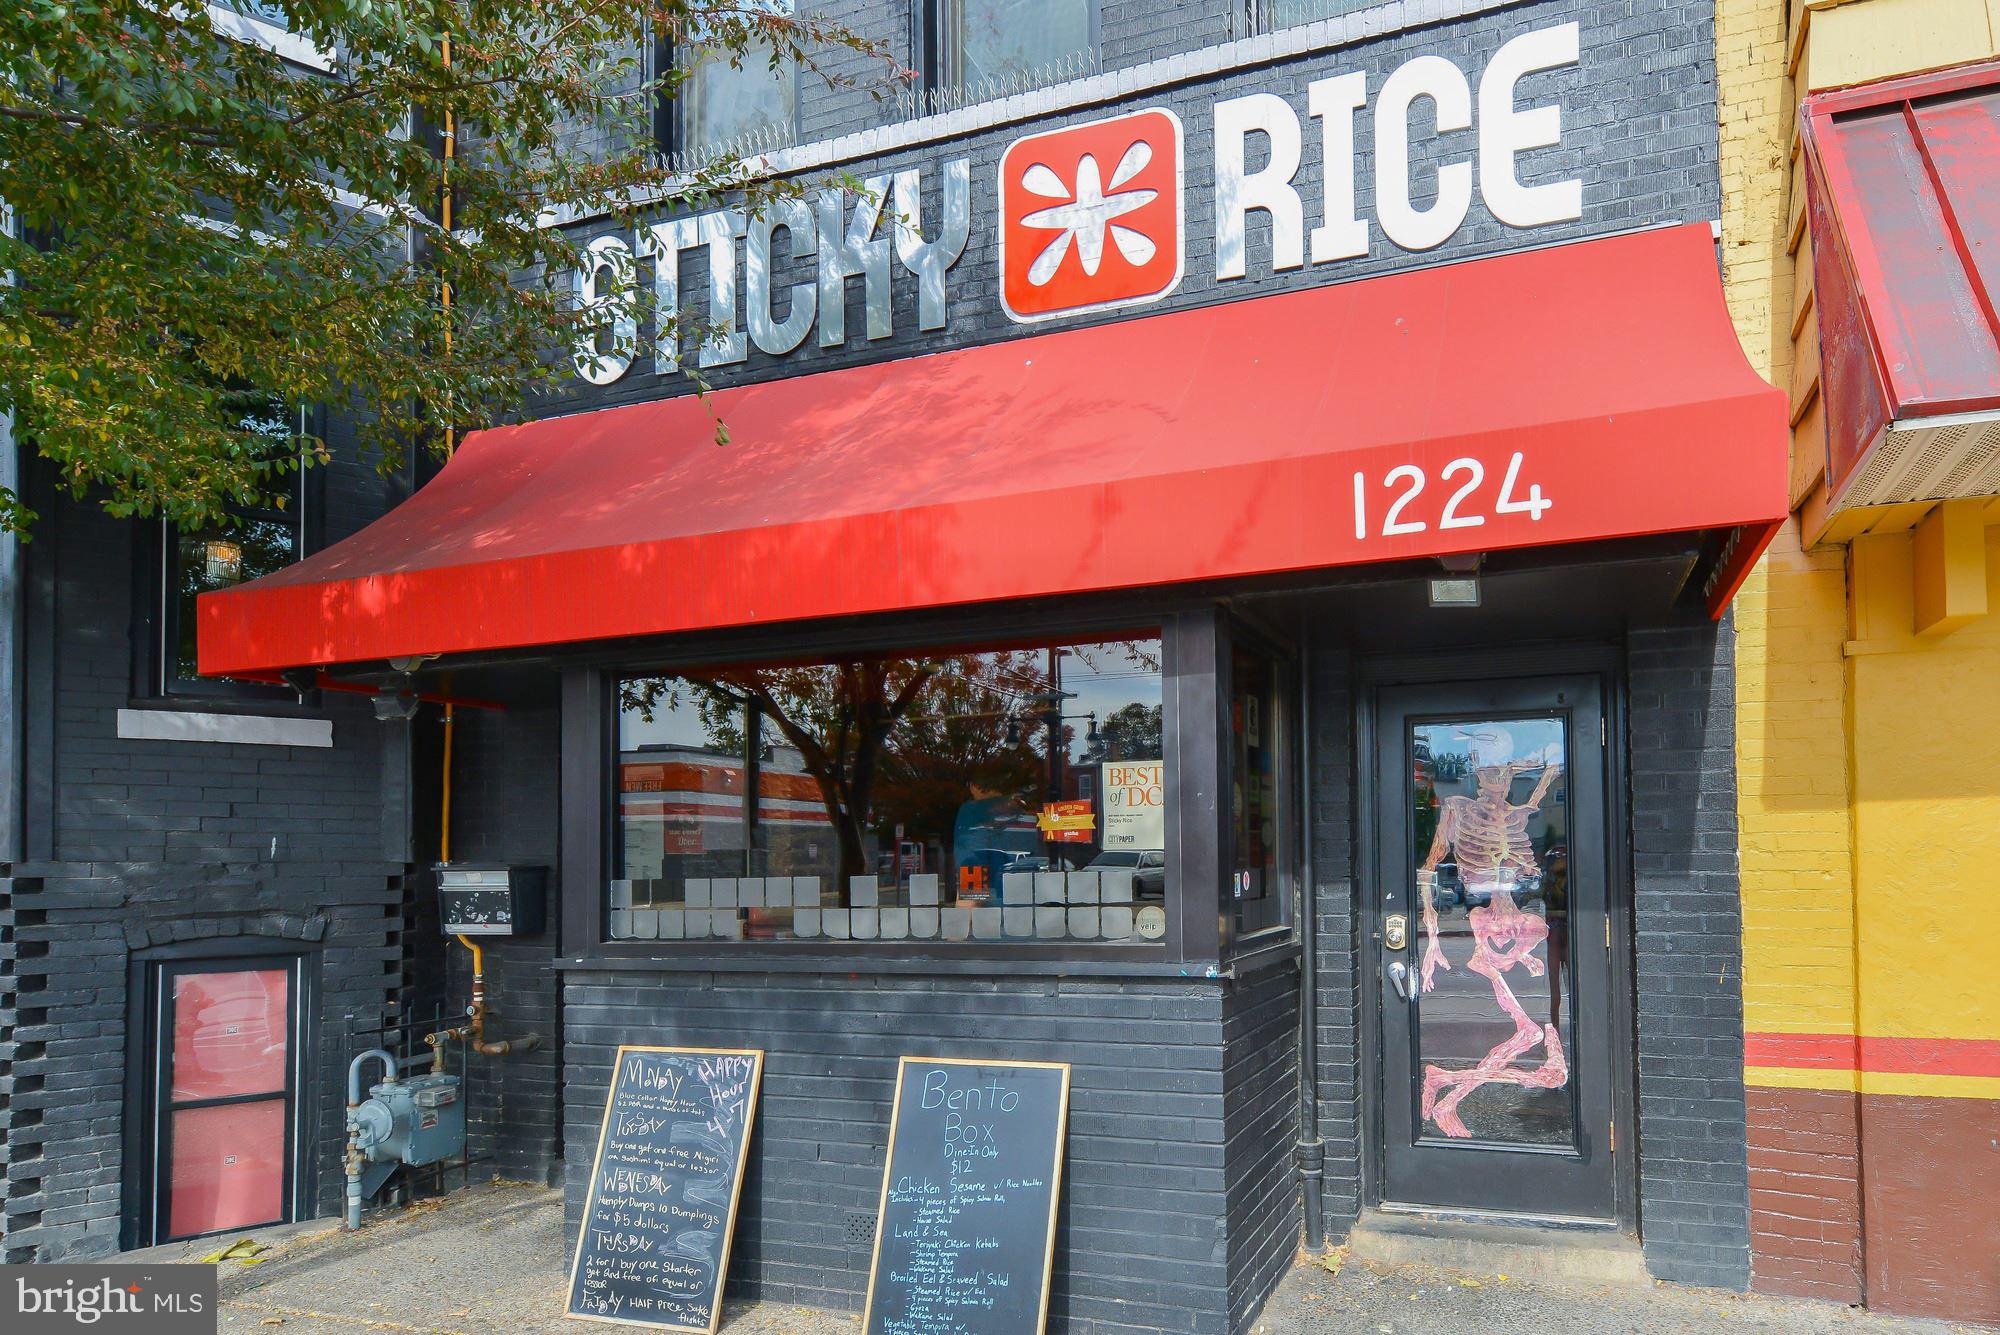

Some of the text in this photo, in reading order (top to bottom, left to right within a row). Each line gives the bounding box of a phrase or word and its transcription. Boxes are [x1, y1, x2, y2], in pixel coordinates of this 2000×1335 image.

[572, 22, 1584, 386] STICKY RICE
[1353, 451, 1552, 540] 1224
[1108, 767, 1164, 786] BEST
[1110, 787, 1125, 806] of
[697, 1056, 752, 1085] HAPPY
[619, 1091, 635, 1099] Blue
[708, 1081, 747, 1108] Hour
[921, 1069, 1019, 1112] Bento
[944, 1112, 994, 1144] Box
[610, 1140, 624, 1152] Buy
[638, 1142, 653, 1156] get
[668, 1146, 690, 1159] free
[693, 1151, 720, 1165] Nigiri
[981, 1145, 999, 1159] Only
[949, 1157, 973, 1175] $12
[897, 1176, 940, 1194] Chicken
[949, 1176, 986, 1194] Sesame
[1006, 1178, 1019, 1188] Rice
[926, 1198, 947, 1207] pieces
[949, 1195, 957, 1204] of
[960, 1195, 975, 1206] Spicy
[948, 1206, 961, 1214] Rice
[596, 1210, 611, 1221] for
[633, 1214, 669, 1234] dollars
[629, 1197, 655, 1212] Dumps
[658, 1205, 668, 1214] 10
[671, 1206, 720, 1229] Dumplings
[935, 1215, 953, 1224] Salad
[894, 1224, 948, 1238] Land & Sea
[944, 1240, 971, 1249] Chicken
[975, 1236, 999, 1250] Kebabs
[586, 1255, 593, 1267] 2
[595, 1257, 609, 1267] for
[620, 1259, 638, 1274] buy
[638, 1260, 659, 1270] one
[662, 1261, 702, 1277] Starter
[938, 1265, 954, 1274] Salad
[586, 1268, 601, 1278] get
[622, 1271, 641, 1282] free
[662, 1277, 687, 1290] equal
[690, 1281, 703, 1290] or
[890, 1271, 1009, 1287] Broiled Eel & Seaweed Salad
[945, 1286, 960, 1297] Rice
[974, 1287, 986, 1295] Eel
[686, 1303, 711, 1319] Sake
[944, 1297, 959, 1307] Spicy
[884, 1316, 916, 1332] Vegetable
[920, 1320, 950, 1333] Tempura
[937, 1312, 954, 1321] Salad
